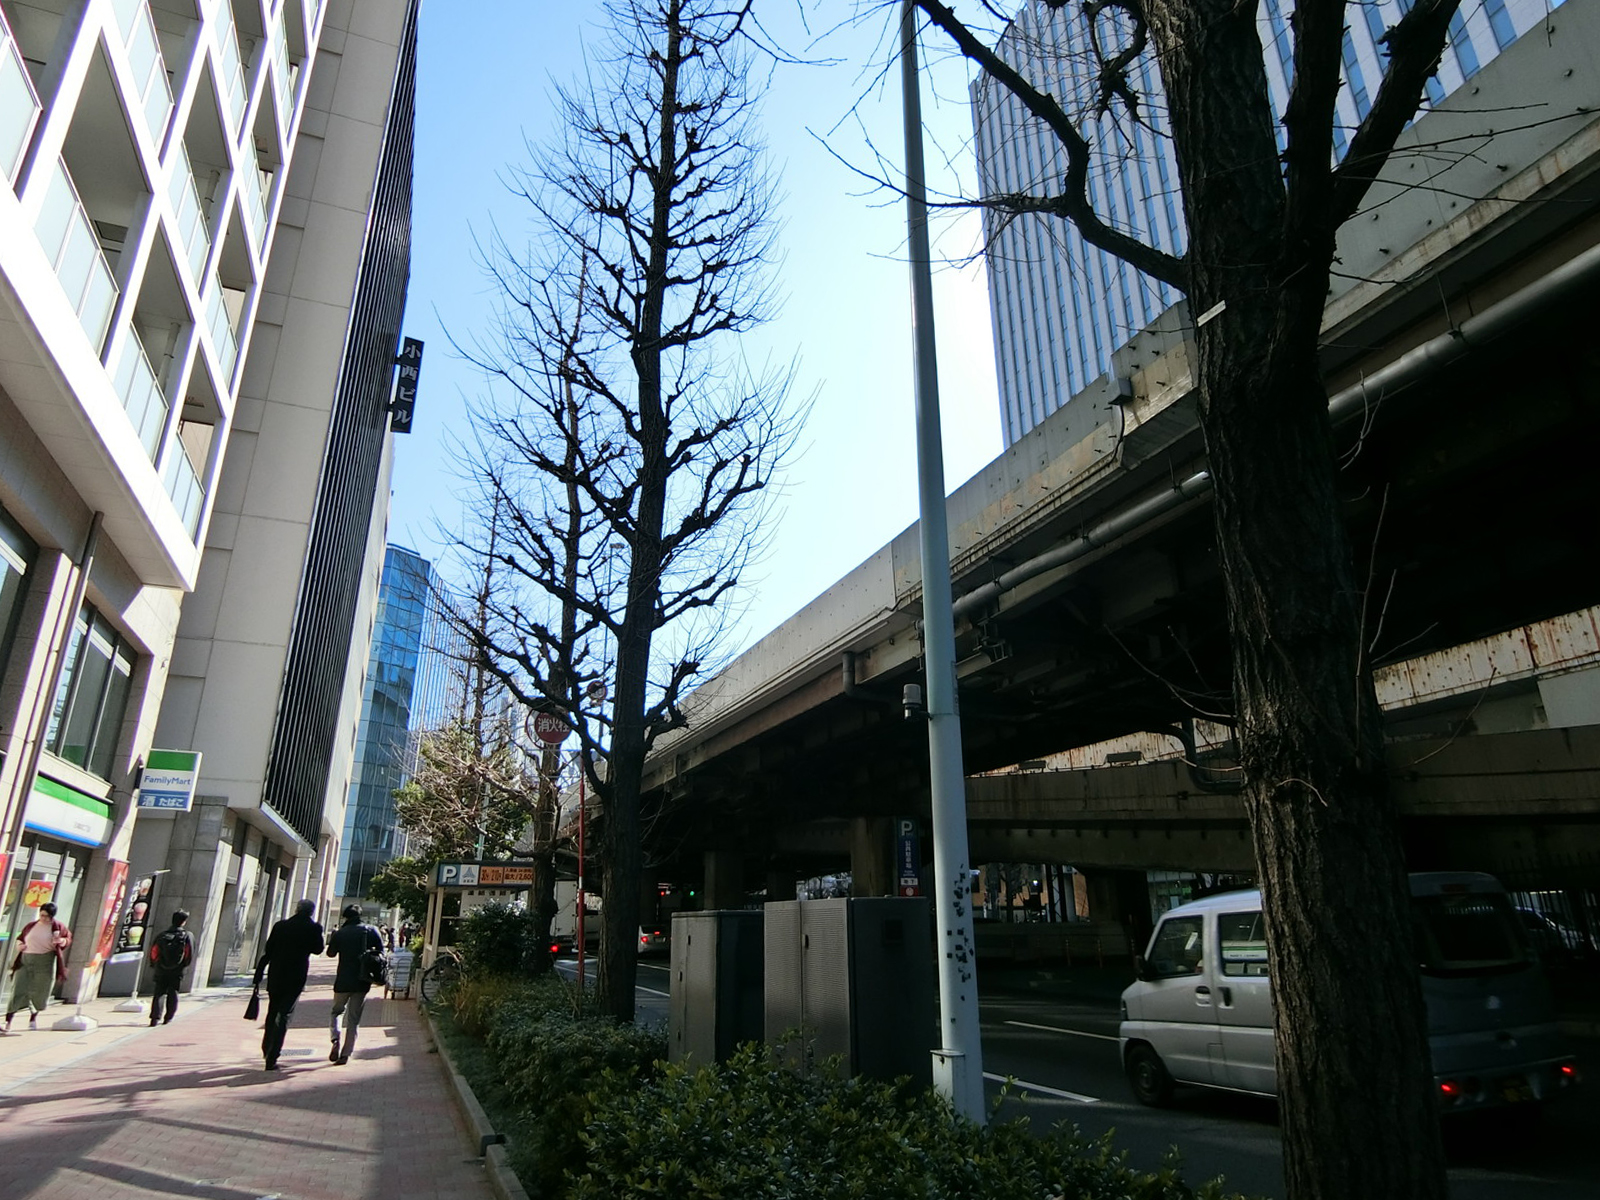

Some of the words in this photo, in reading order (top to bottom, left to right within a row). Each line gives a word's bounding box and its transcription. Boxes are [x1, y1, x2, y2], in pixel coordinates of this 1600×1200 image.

[394, 344, 421, 424] 小西ビル
[144, 775, 191, 785] FamilyMart
[142, 795, 156, 807] 酒
[158, 797, 184, 807] たばこ
[901, 820, 913, 836] P
[443, 866, 457, 882] P
